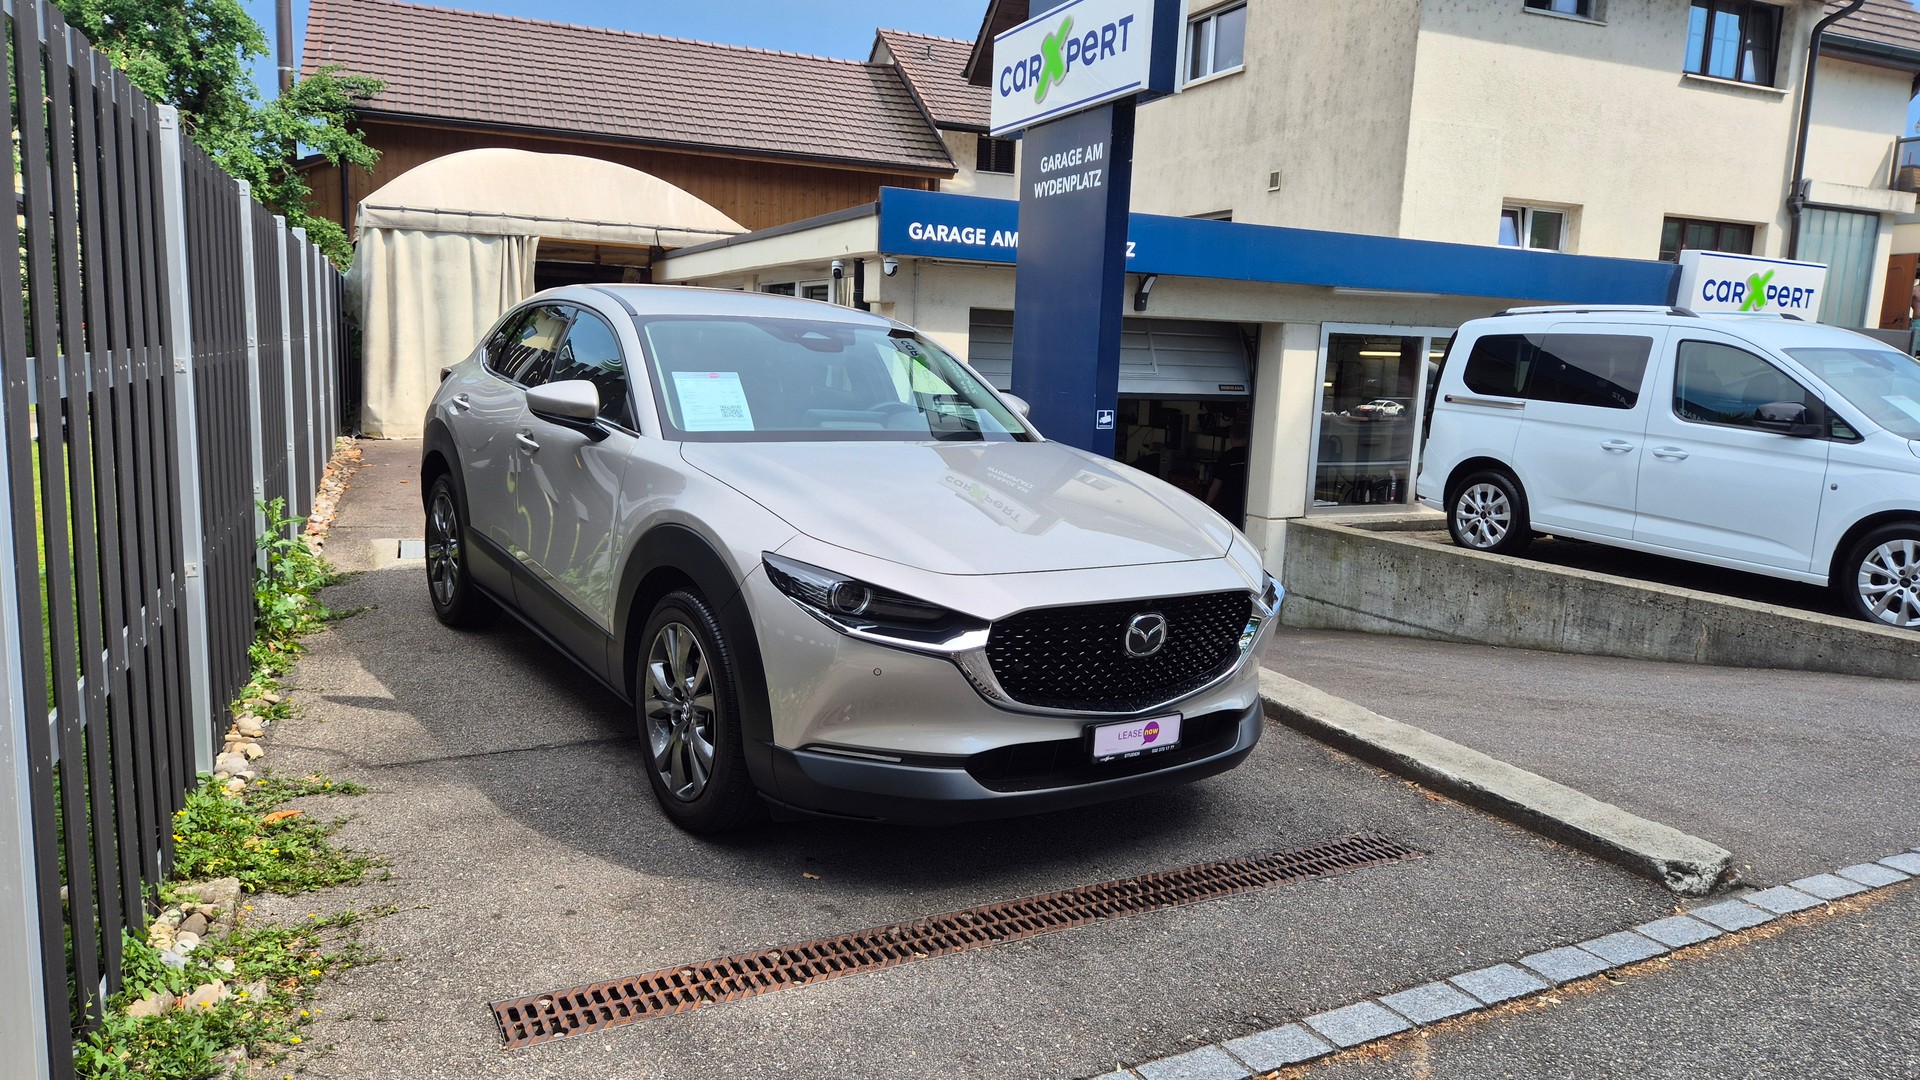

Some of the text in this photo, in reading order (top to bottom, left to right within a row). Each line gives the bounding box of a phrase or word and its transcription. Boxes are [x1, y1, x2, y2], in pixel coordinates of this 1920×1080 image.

[1040, 142, 1103, 173] GARAGE AM
[1034, 169, 1102, 199] WYDENPLATZ
[908, 222, 1019, 248] GARAGE AM
[1117, 728, 1159, 740] LEASE now
